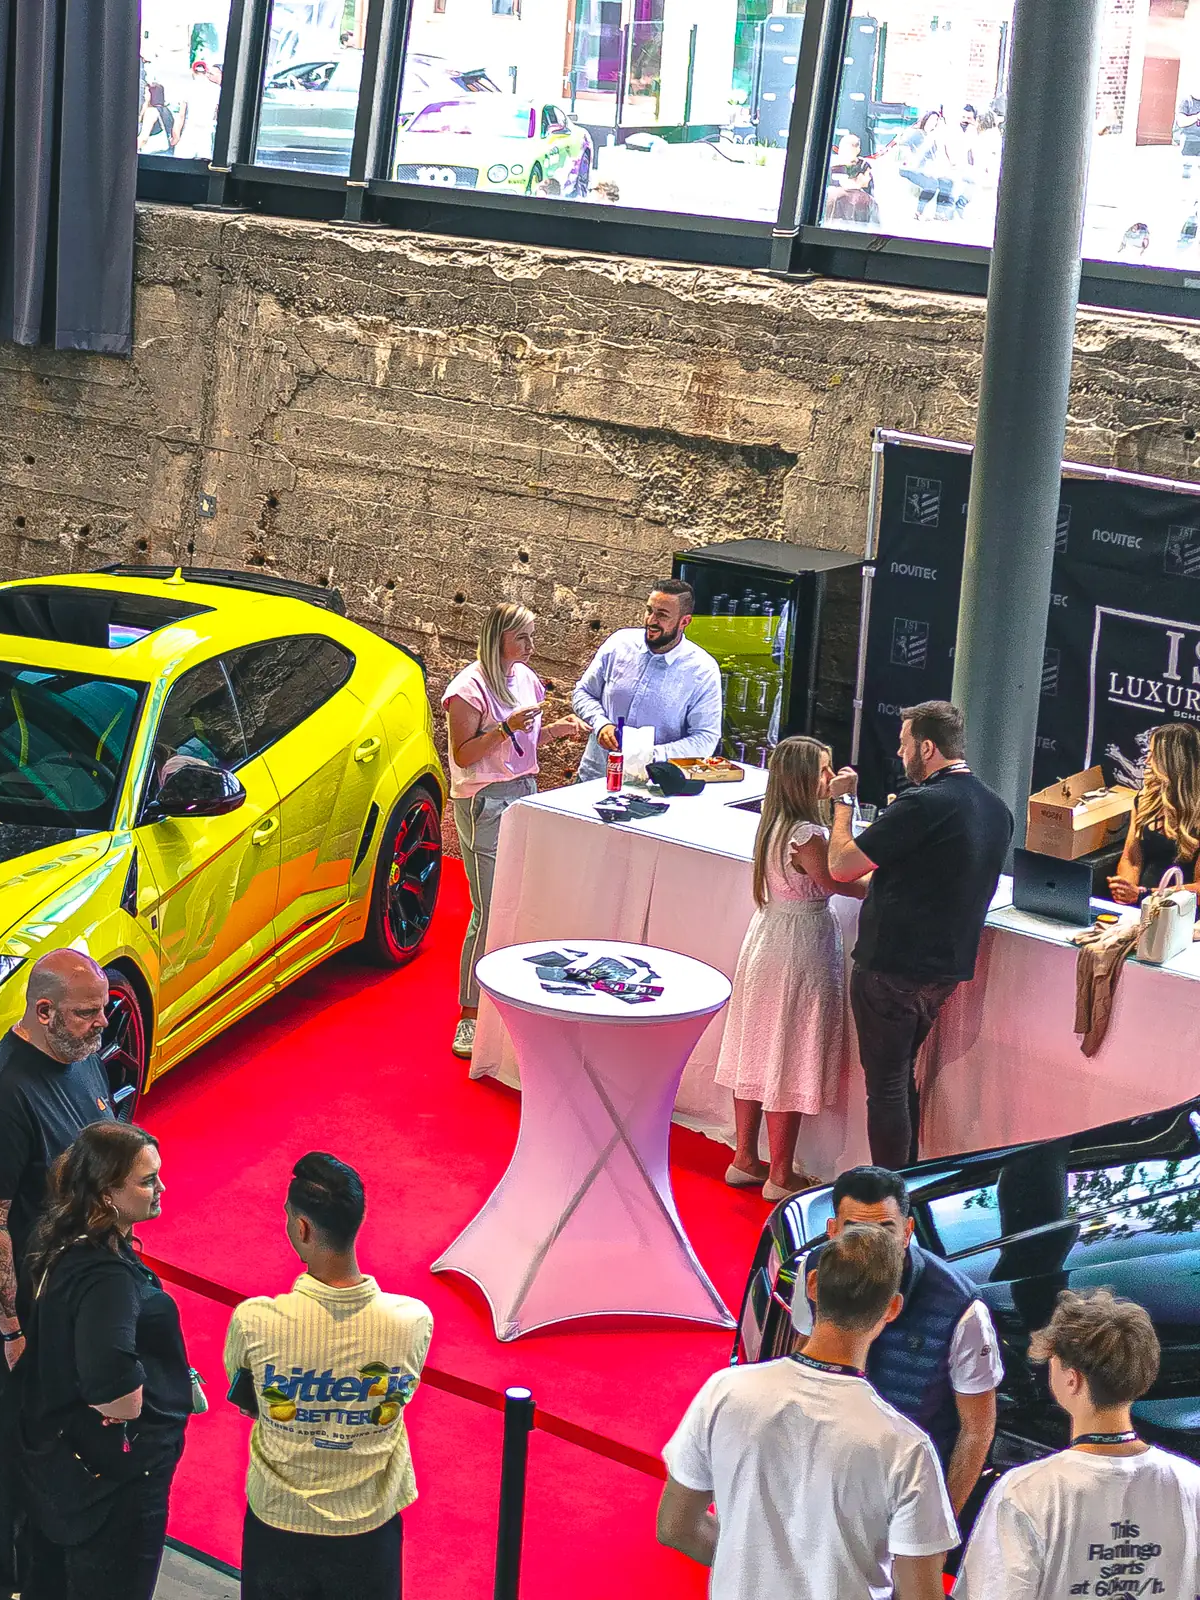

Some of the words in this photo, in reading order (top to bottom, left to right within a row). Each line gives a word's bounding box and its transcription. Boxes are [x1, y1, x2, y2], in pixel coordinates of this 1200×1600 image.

[263, 1364, 381, 1402] bitter
[295, 1407, 373, 1426] BETTER
[1070, 1580, 1091, 1595] at
